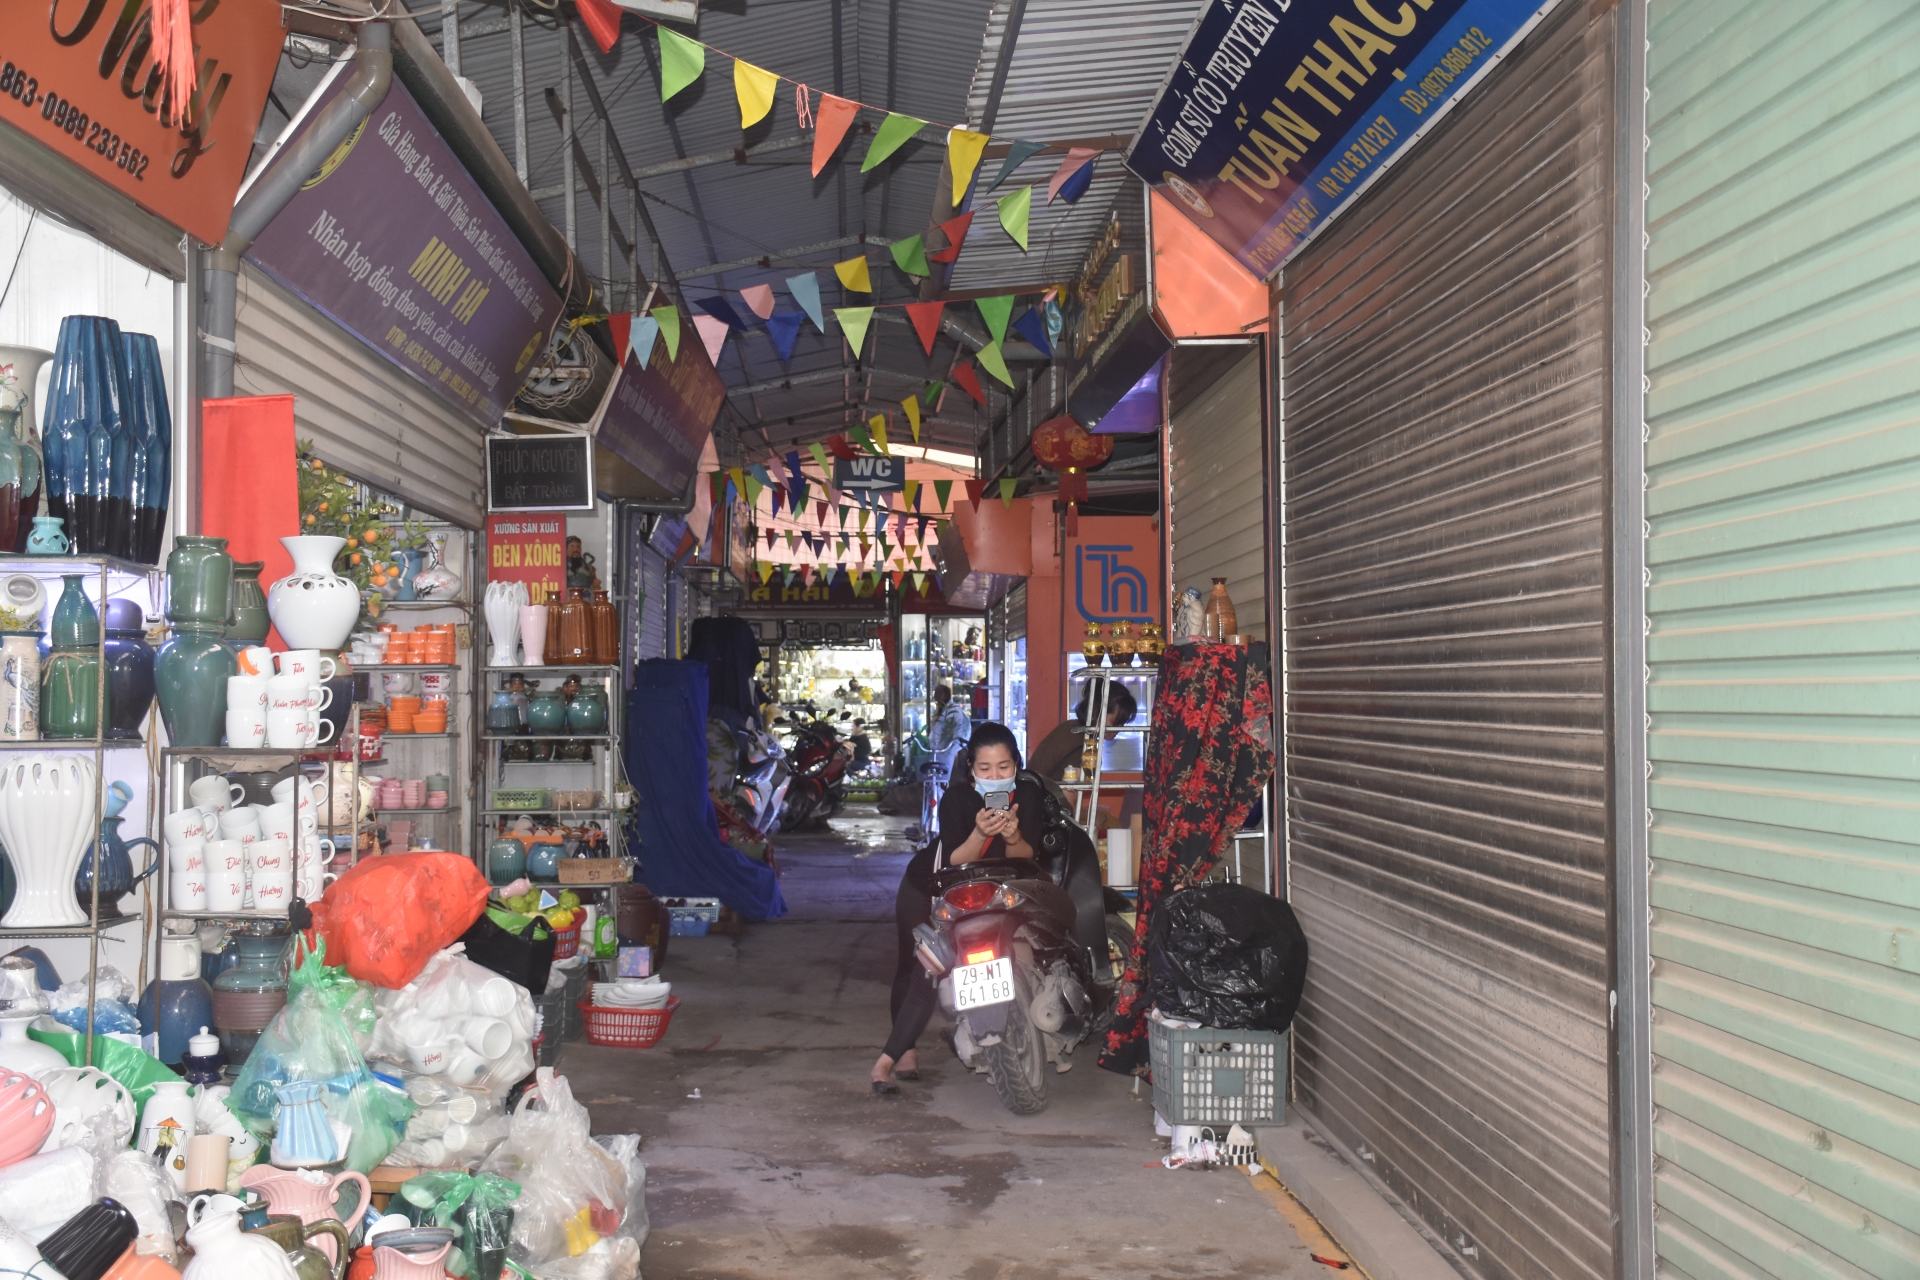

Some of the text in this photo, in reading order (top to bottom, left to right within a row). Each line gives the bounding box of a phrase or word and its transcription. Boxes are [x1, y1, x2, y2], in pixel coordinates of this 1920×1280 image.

[1183, 60, 1228, 115] CỔ
[1217, 0, 1435, 204] TUẤN THẠC
[379, 111, 402, 147] Cửa
[1175, 91, 1213, 138] SỨ
[394, 130, 421, 174] Hàng
[1156, 119, 1202, 168] GỐM
[414, 155, 434, 189] Bán
[428, 174, 444, 197] &
[435, 182, 457, 212] Giới
[1316, 176, 1344, 199] NR
[447, 196, 469, 231] Thiệu
[464, 217, 481, 244] Sản
[474, 229, 496, 261] Phẩm
[488, 247, 506, 273] Gốm
[307, 209, 348, 257] Nhận
[343, 241, 372, 282] hợp
[367, 265, 400, 307] đồng
[394, 289, 419, 321] theo
[412, 311, 436, 336] yêu
[432, 321, 453, 348] cầu
[448, 336, 466, 359] của
[461, 344, 485, 377] khách
[407, 235, 492, 326] MINH HÀ
[495, 444, 529, 474] PHÚC
[850, 458, 892, 477] WC
[494, 518, 560, 534] XƯỞNG SẢN XUẤT
[493, 538, 562, 568] ĐÈN XÔNG
[257, 856, 280, 869] Chung
[961, 962, 1002, 986] 29-N1
[958, 980, 1011, 1007] 641.68
